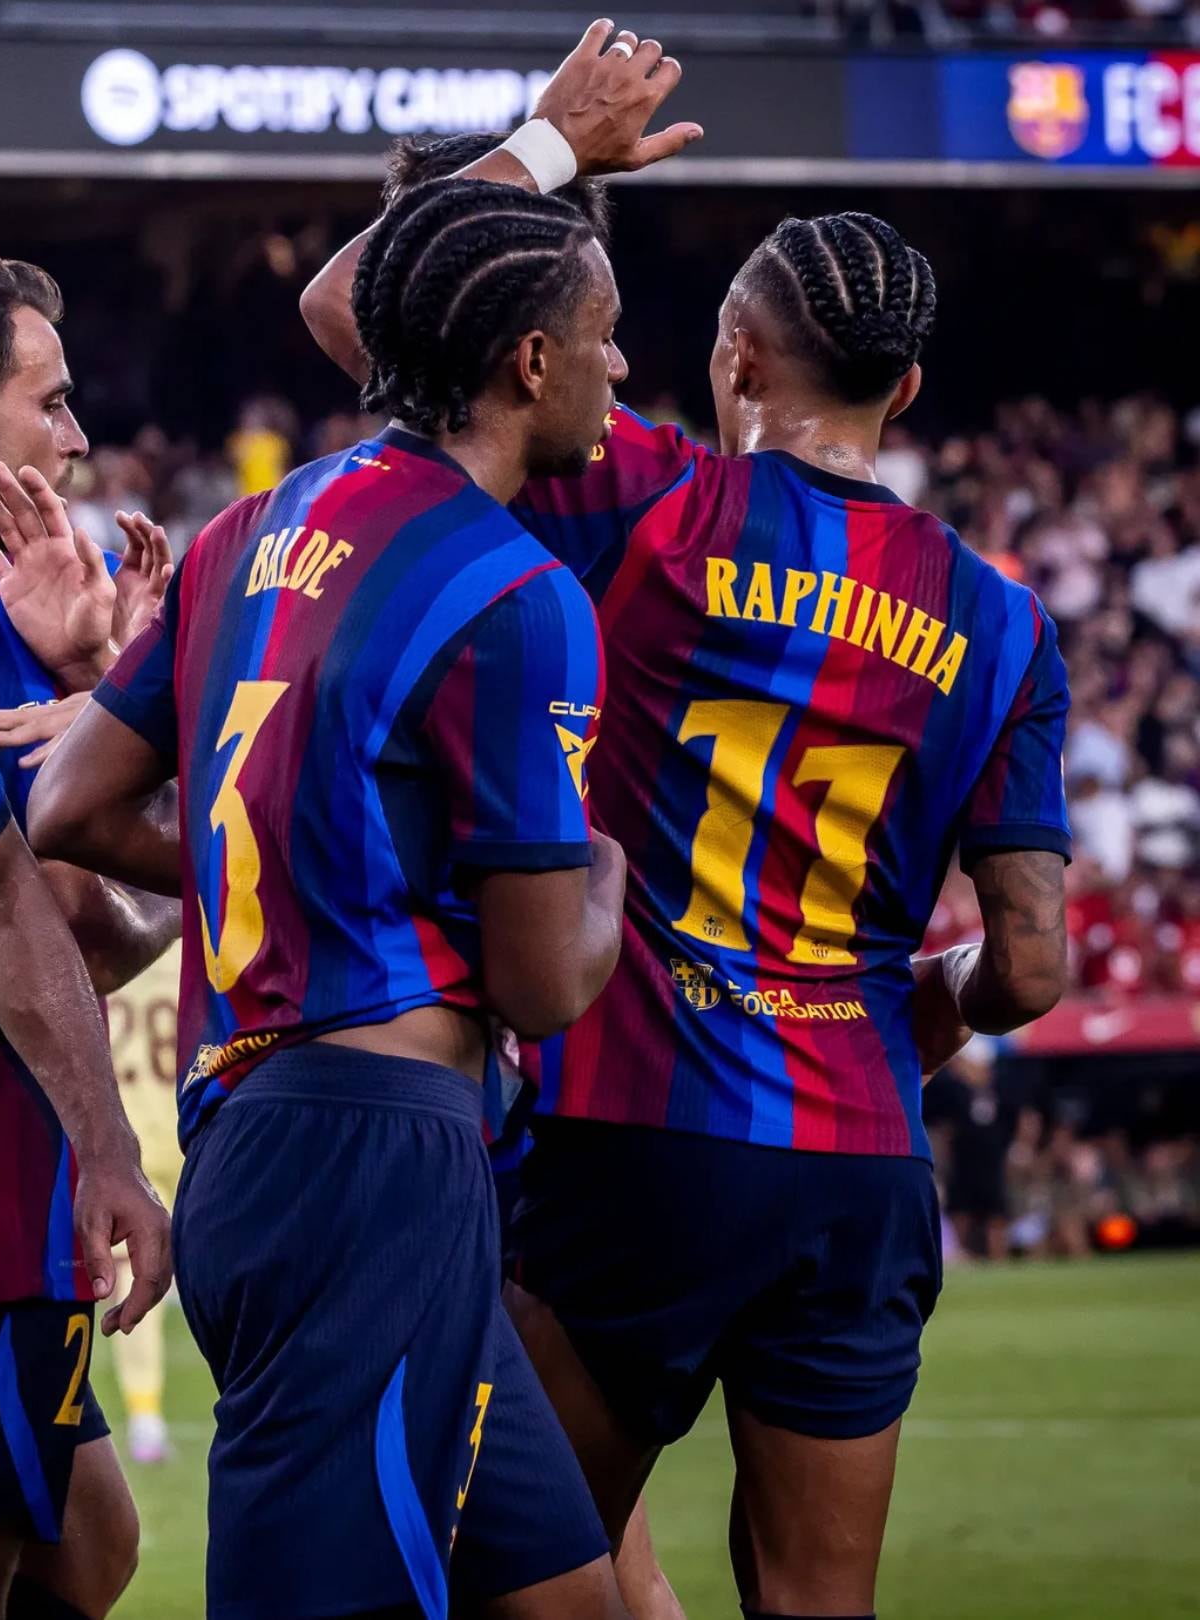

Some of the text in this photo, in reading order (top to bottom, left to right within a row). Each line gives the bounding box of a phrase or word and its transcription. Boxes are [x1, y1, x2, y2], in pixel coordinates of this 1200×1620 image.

[161, 63, 375, 134] SPOTIFY
[374, 66, 524, 134] CAMP
[245, 526, 354, 600] BALDE
[706, 556, 969, 697] RAPHINHA
[197, 680, 291, 994] 3
[671, 699, 908, 966] 11
[54, 1313, 91, 1426] 2
